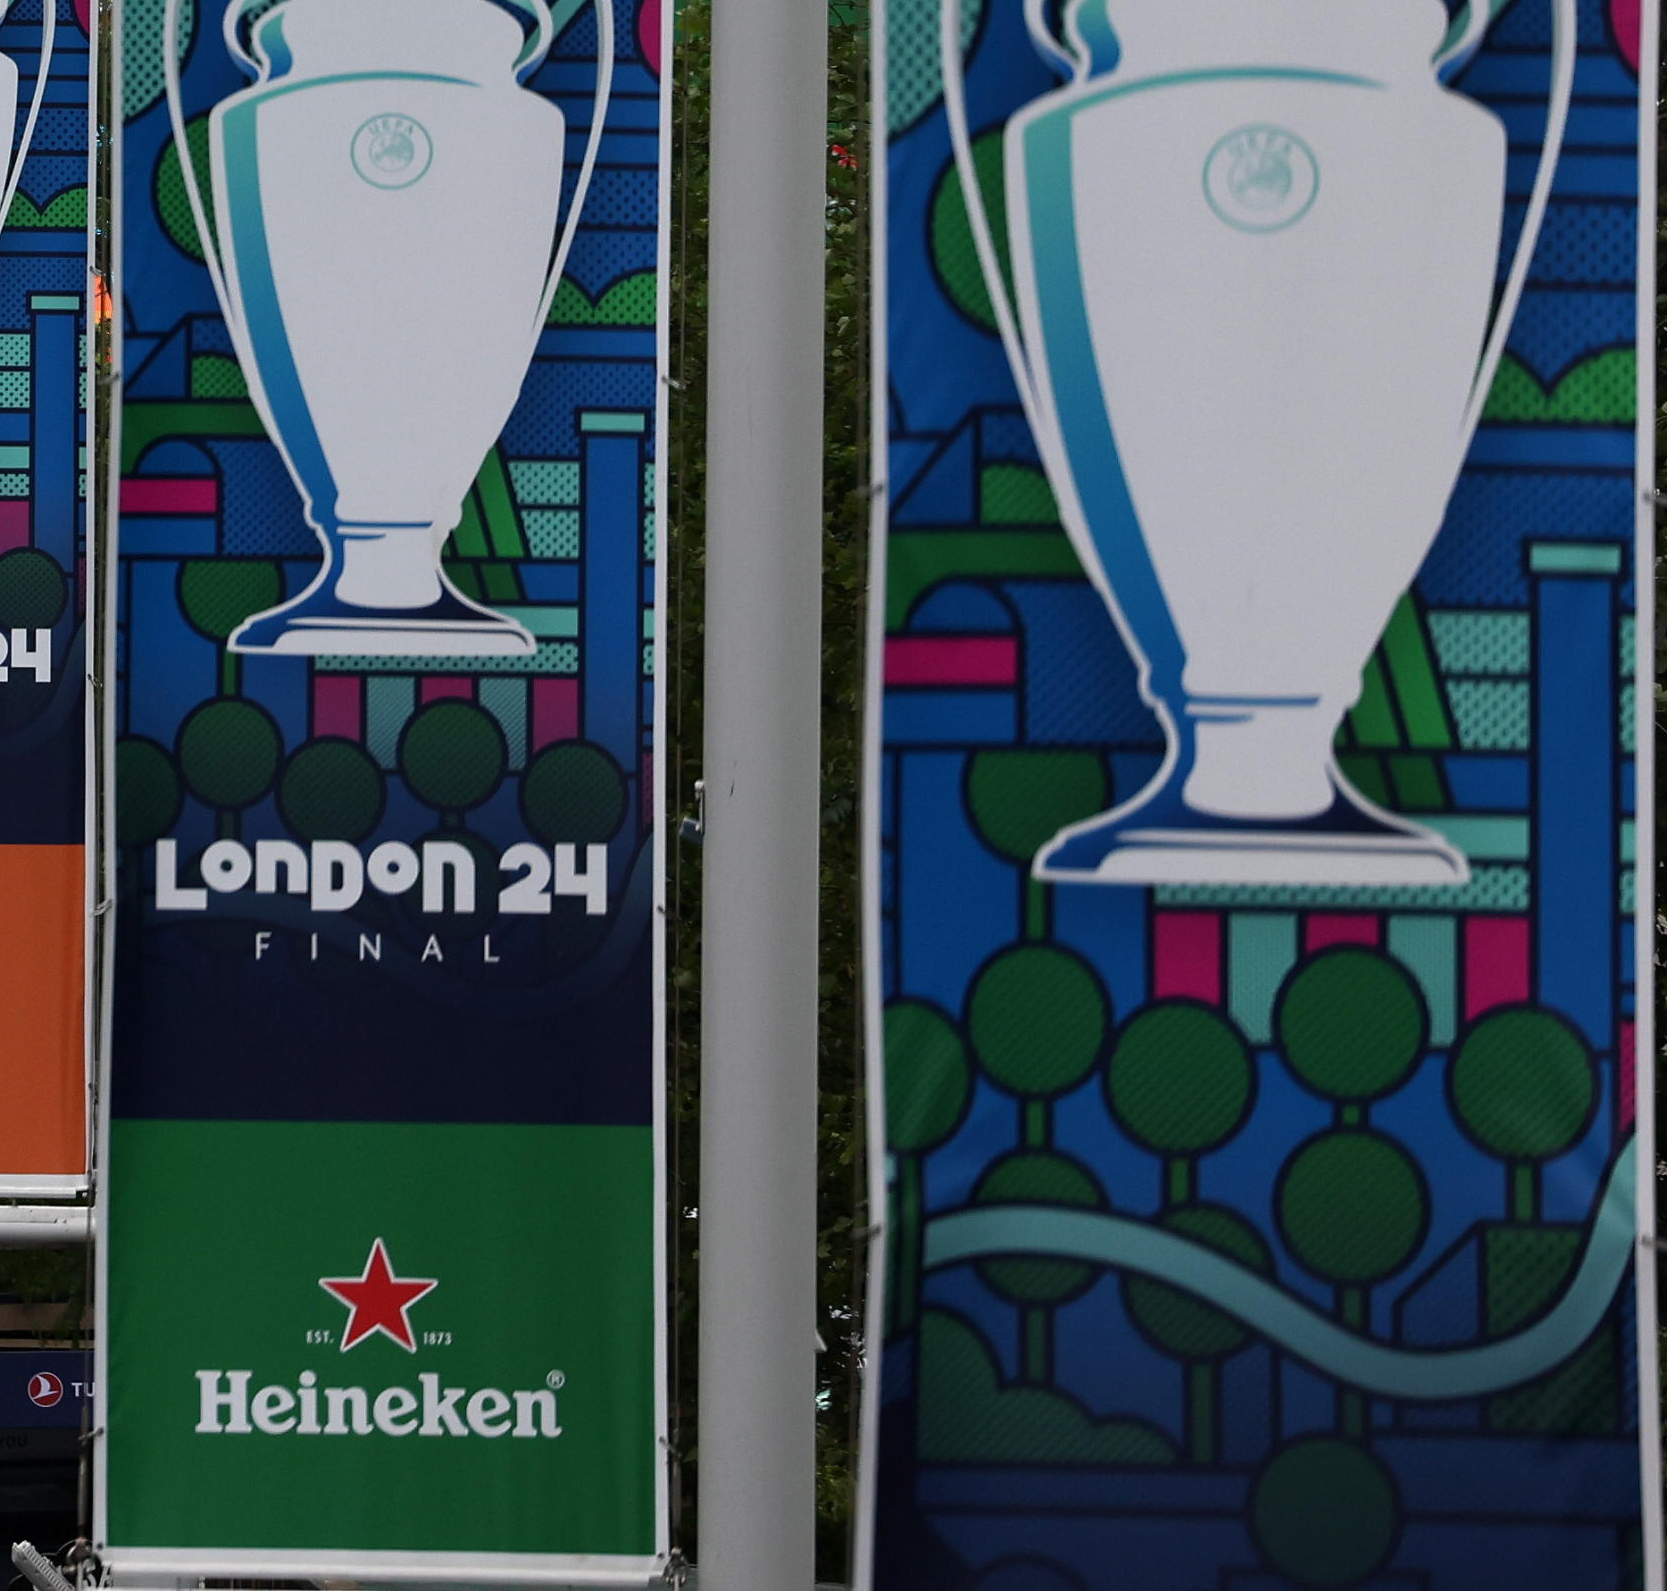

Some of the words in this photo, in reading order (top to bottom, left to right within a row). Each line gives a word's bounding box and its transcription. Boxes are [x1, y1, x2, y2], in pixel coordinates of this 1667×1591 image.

[498, 841, 609, 915] 24
[255, 931, 500, 963] FINAL
[306, 1329, 335, 1345] EST.
[423, 1330, 453, 1346] 1873
[195, 1368, 563, 1439] Heineken
